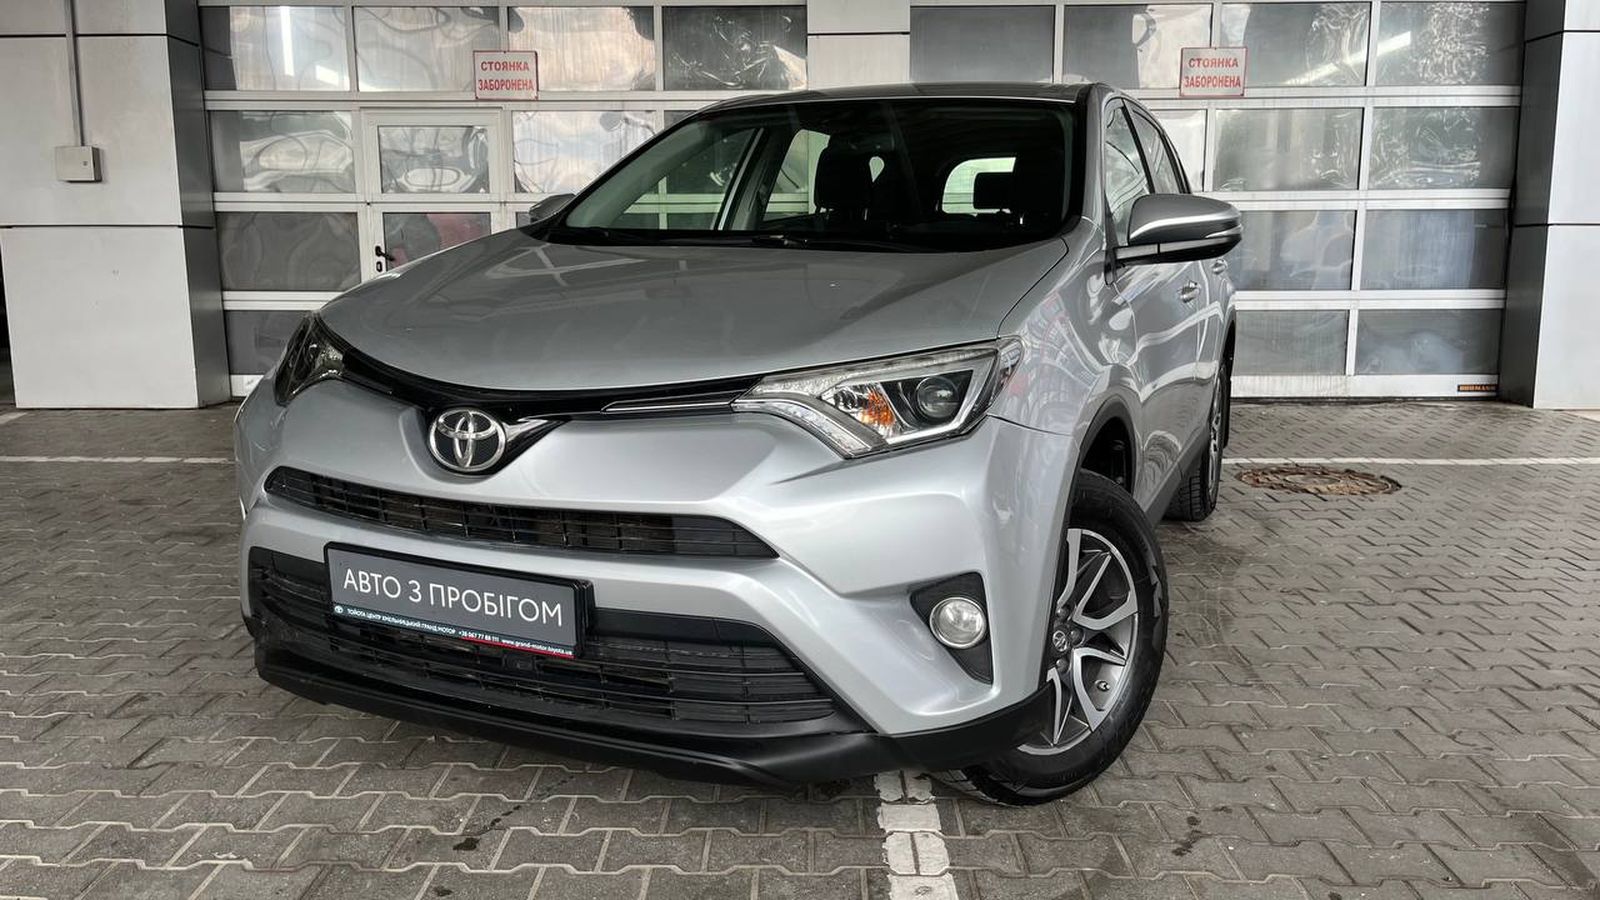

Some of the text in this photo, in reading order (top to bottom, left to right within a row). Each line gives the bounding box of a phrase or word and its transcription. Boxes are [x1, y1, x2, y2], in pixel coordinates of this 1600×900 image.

[481, 61, 530, 71] СТОЯНКА
[1188, 58, 1239, 68] СТОЯНКА
[479, 79, 534, 91] ЗАБОРОНЕНА
[1184, 75, 1241, 88] ЗАБОРОНЕНА
[343, 568, 401, 599] АВТО
[429, 583, 563, 627] ПРОБІГОМ
